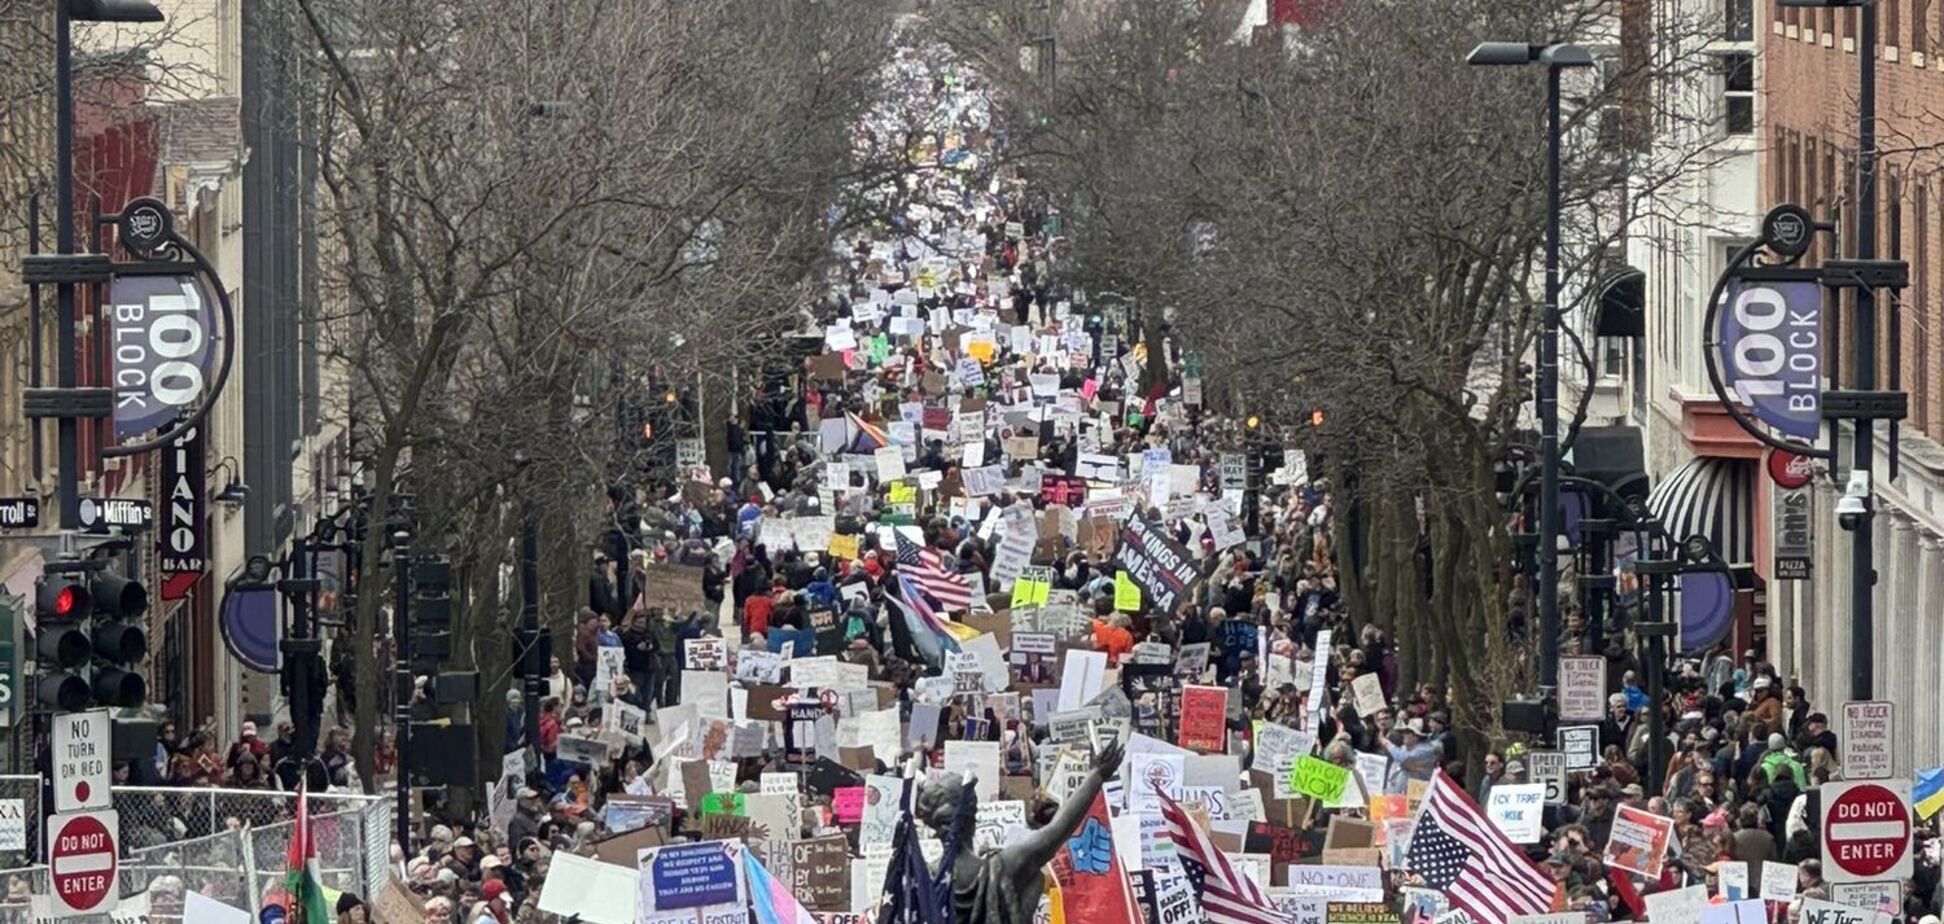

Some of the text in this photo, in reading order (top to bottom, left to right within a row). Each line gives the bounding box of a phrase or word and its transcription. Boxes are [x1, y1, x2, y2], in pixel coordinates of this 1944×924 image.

[149, 279, 203, 405] 100
[1735, 287, 1787, 407] 100
[116, 303, 147, 410] BLOCK
[1788, 309, 1818, 412] BLOCK
[1223, 466, 1243, 475] WAY
[103, 501, 142, 524] Mifflin
[163, 558, 201, 570] BAR
[1174, 562, 1197, 585] IN
[71, 719, 90, 740] NO
[67, 742, 95, 759] TURN
[1532, 754, 1563, 766] SPEED
[62, 760, 103, 779] ON RED
[1294, 769, 1346, 799] NOW
[1839, 801, 1896, 818] DO NOT
[62, 833, 105, 852] DO NOT
[1841, 843, 1895, 860] ENTER
[794, 844, 813, 864] OF
[64, 875, 105, 894] ENTER
[1301, 870, 1324, 886] NO
[1163, 899, 1192, 923] OFF!
